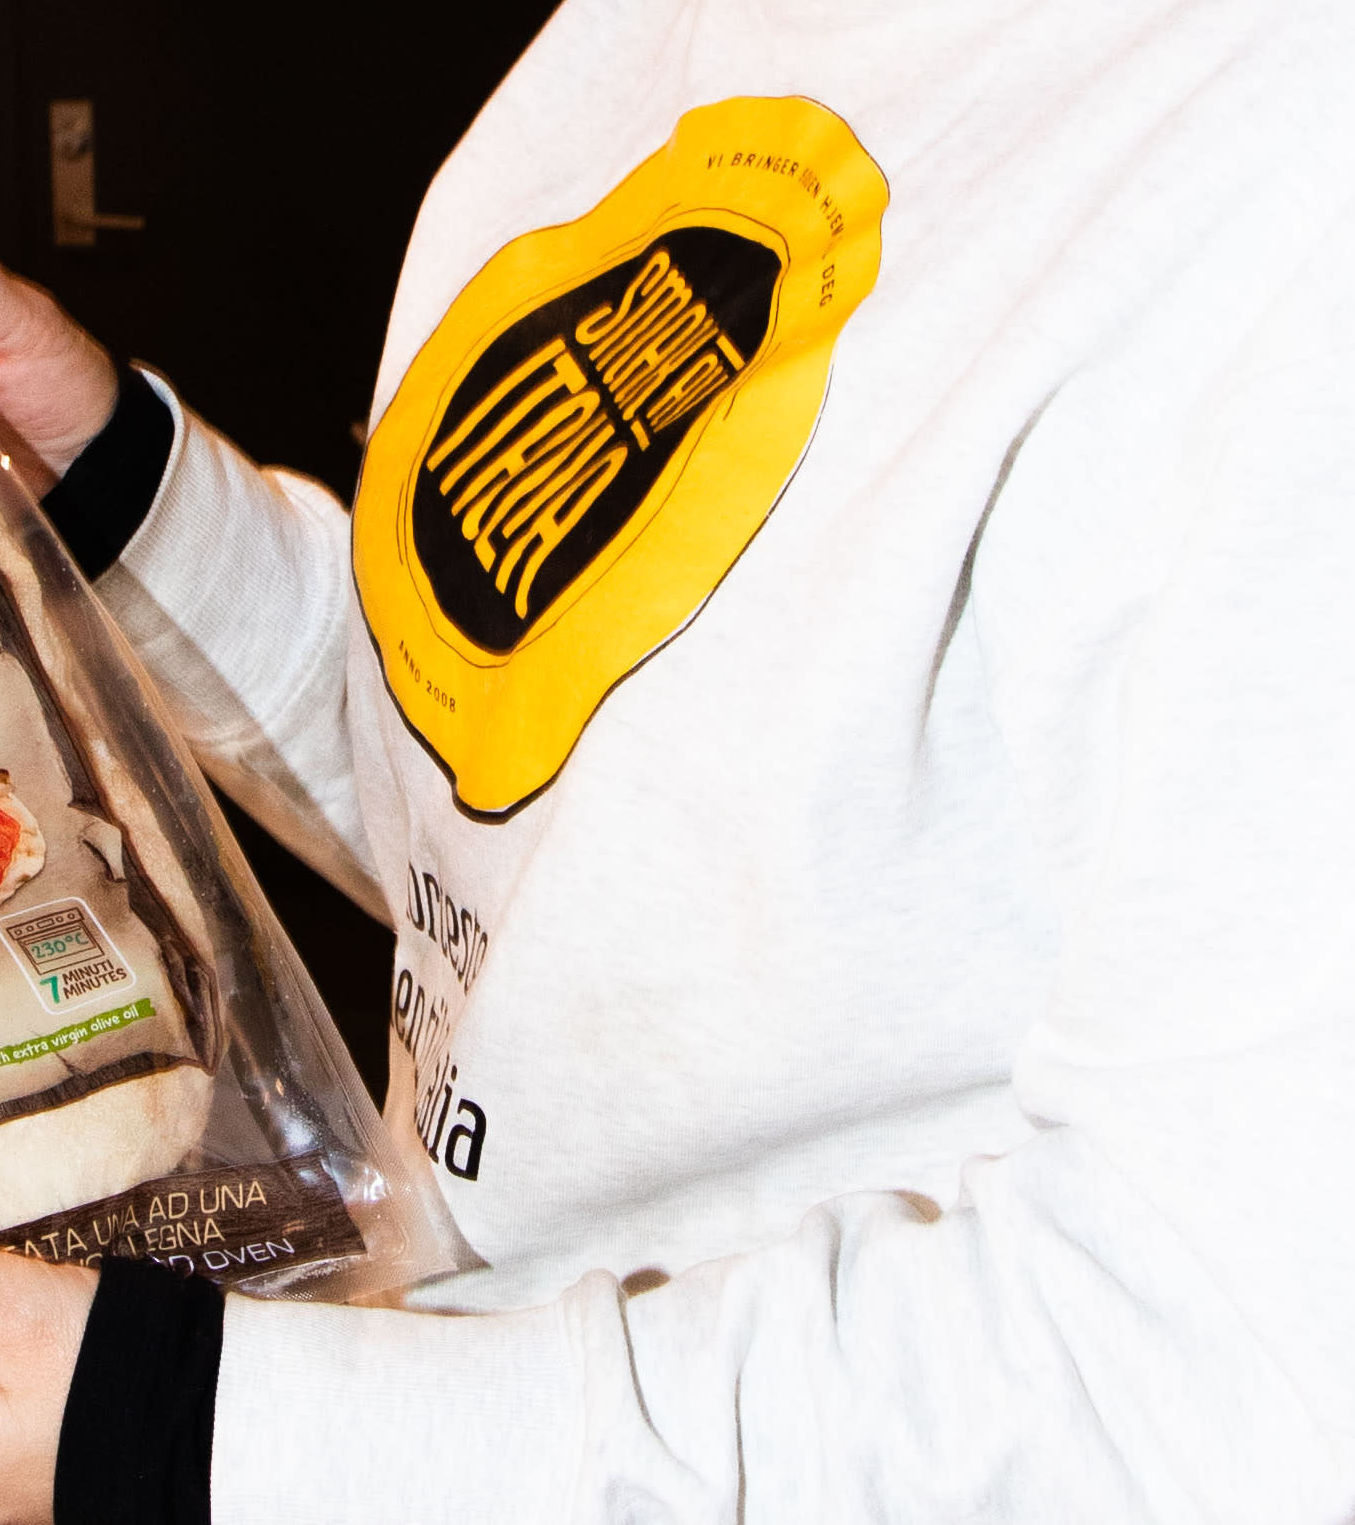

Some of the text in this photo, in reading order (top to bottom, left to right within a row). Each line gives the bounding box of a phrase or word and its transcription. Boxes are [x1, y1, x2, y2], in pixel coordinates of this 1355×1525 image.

[731, 152, 799, 178] BRINGER
[818, 263, 836, 309] DEG
[575, 250, 730, 434] SMAK AV
[426, 337, 628, 620] ITALIA
[426, 679, 457, 713] 2008
[39, 958, 115, 1005] 7 MINUTI
[62, 967, 128, 1000] MINUTES
[12, 1041, 49, 1060] extra
[50, 1027, 89, 1046] virgin
[90, 1015, 122, 1033] olive
[122, 1004, 140, 1021] oil
[92, 1204, 140, 1247] UNA
[149, 1192, 189, 1225] AD
[198, 1180, 268, 1215] UNA
[202, 1237, 297, 1272] OVEN
